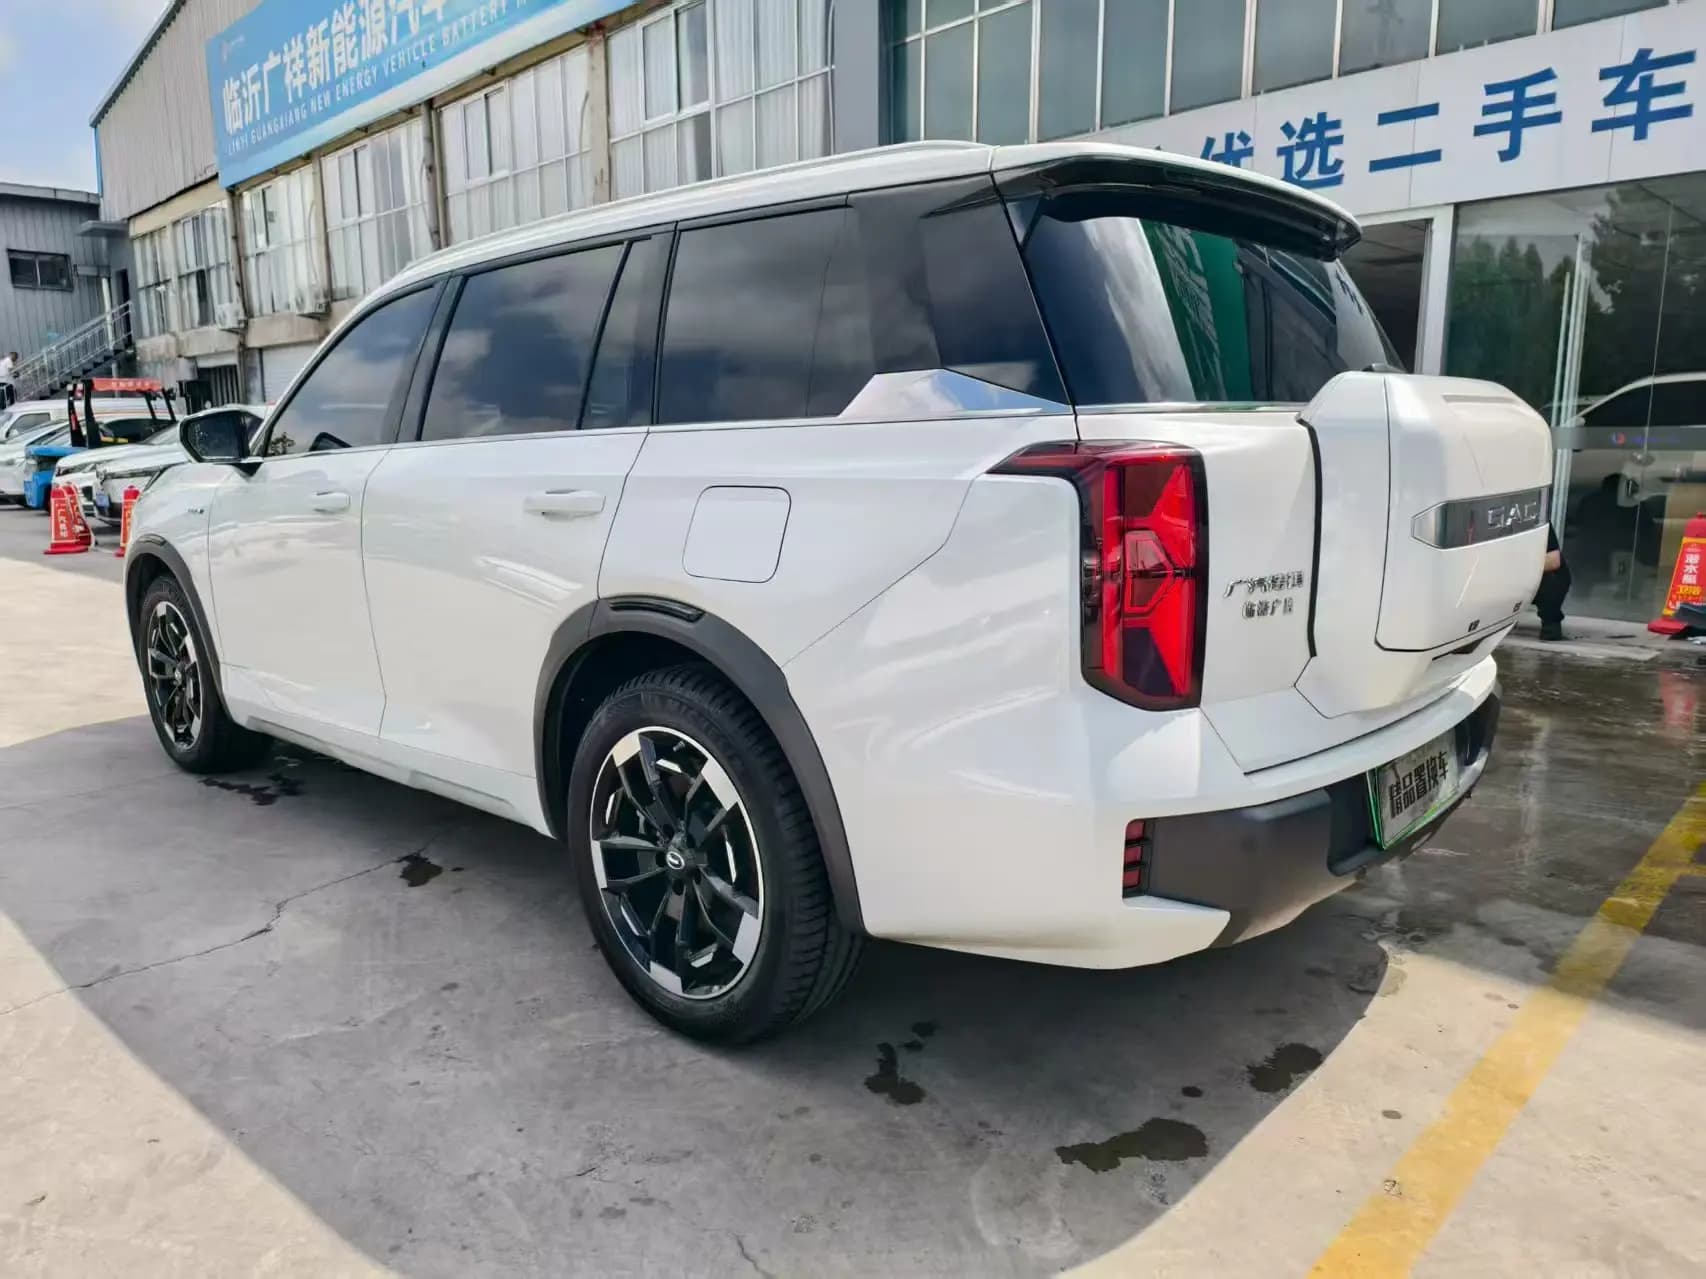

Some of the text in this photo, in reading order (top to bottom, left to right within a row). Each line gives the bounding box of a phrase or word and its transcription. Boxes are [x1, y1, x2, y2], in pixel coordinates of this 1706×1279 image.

[310, 90, 331, 113] NEW
[335, 64, 377, 101] ENERGY
[383, 32, 436, 77] VEHICLE
[1487, 502, 1538, 529] GAC
